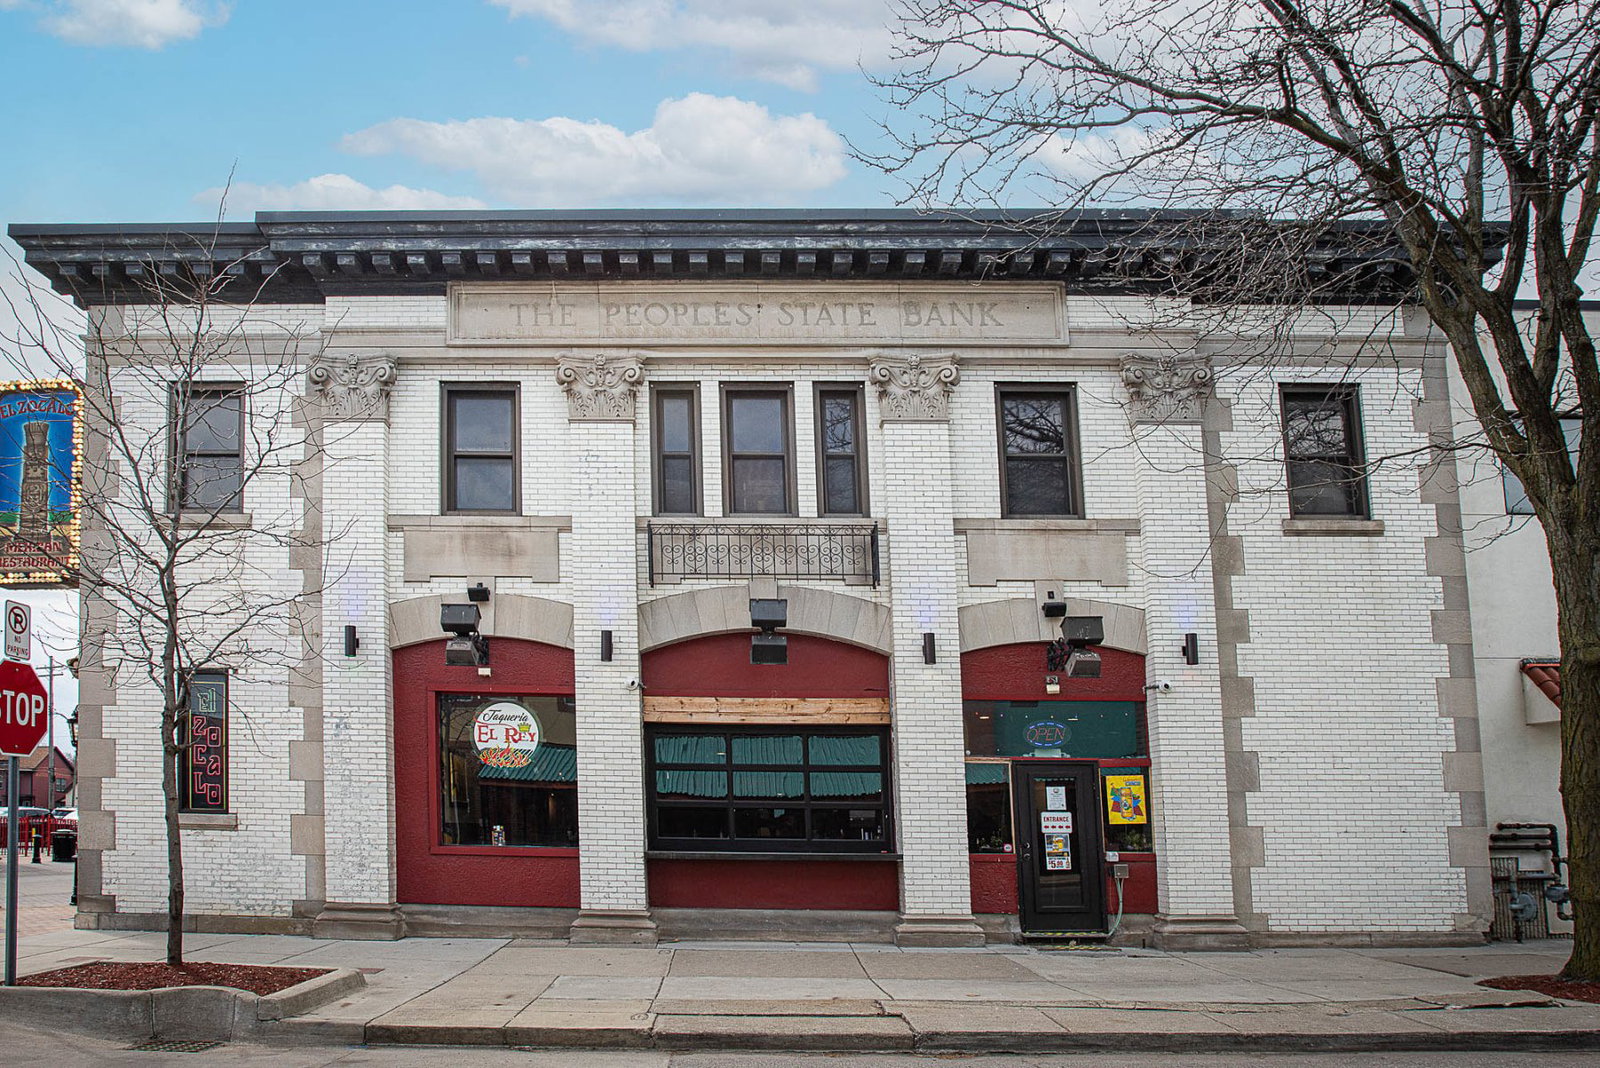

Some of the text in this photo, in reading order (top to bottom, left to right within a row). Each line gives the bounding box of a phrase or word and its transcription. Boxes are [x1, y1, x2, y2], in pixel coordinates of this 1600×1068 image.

[508, 301, 1004, 327] THE PEOPLES STATE BANK
[14, 635, 22, 644] NO
[7, 644, 29, 656] PARKING
[0, 690, 45, 727] TOP
[1026, 727, 1066, 741] OPEN
